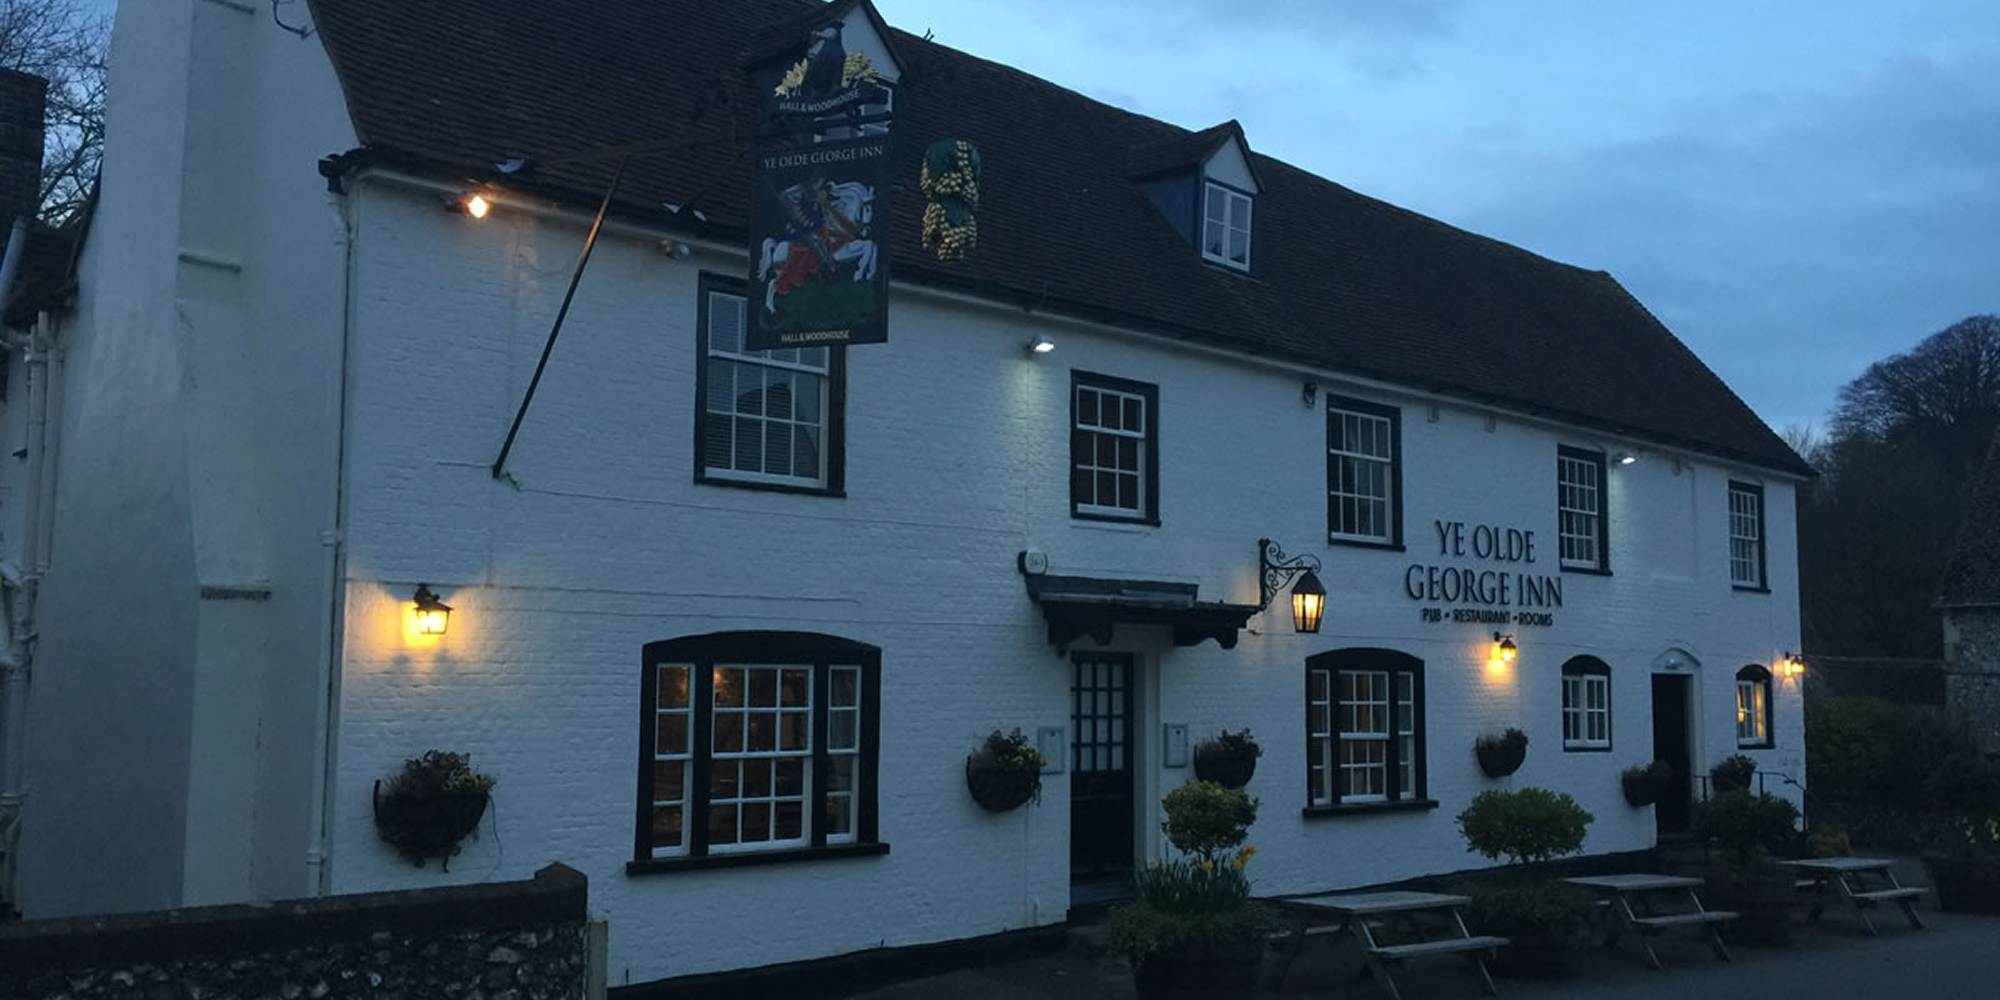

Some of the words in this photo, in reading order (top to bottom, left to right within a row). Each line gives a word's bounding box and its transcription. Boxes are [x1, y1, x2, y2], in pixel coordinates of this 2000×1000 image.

[764, 157, 778, 169] YE
[780, 153, 808, 167] OLDE
[811, 148, 859, 164] GEORGE
[861, 145, 883, 158] INN
[1435, 520, 1466, 555] YE
[1474, 525, 1536, 563] OLDE
[1406, 564, 1511, 605] GEORGE
[1518, 574, 1563, 608] INN
[1422, 608, 1441, 622] PUB
[1453, 609, 1511, 623] RESTAURANT
[1519, 612, 1553, 626] ROOMS
